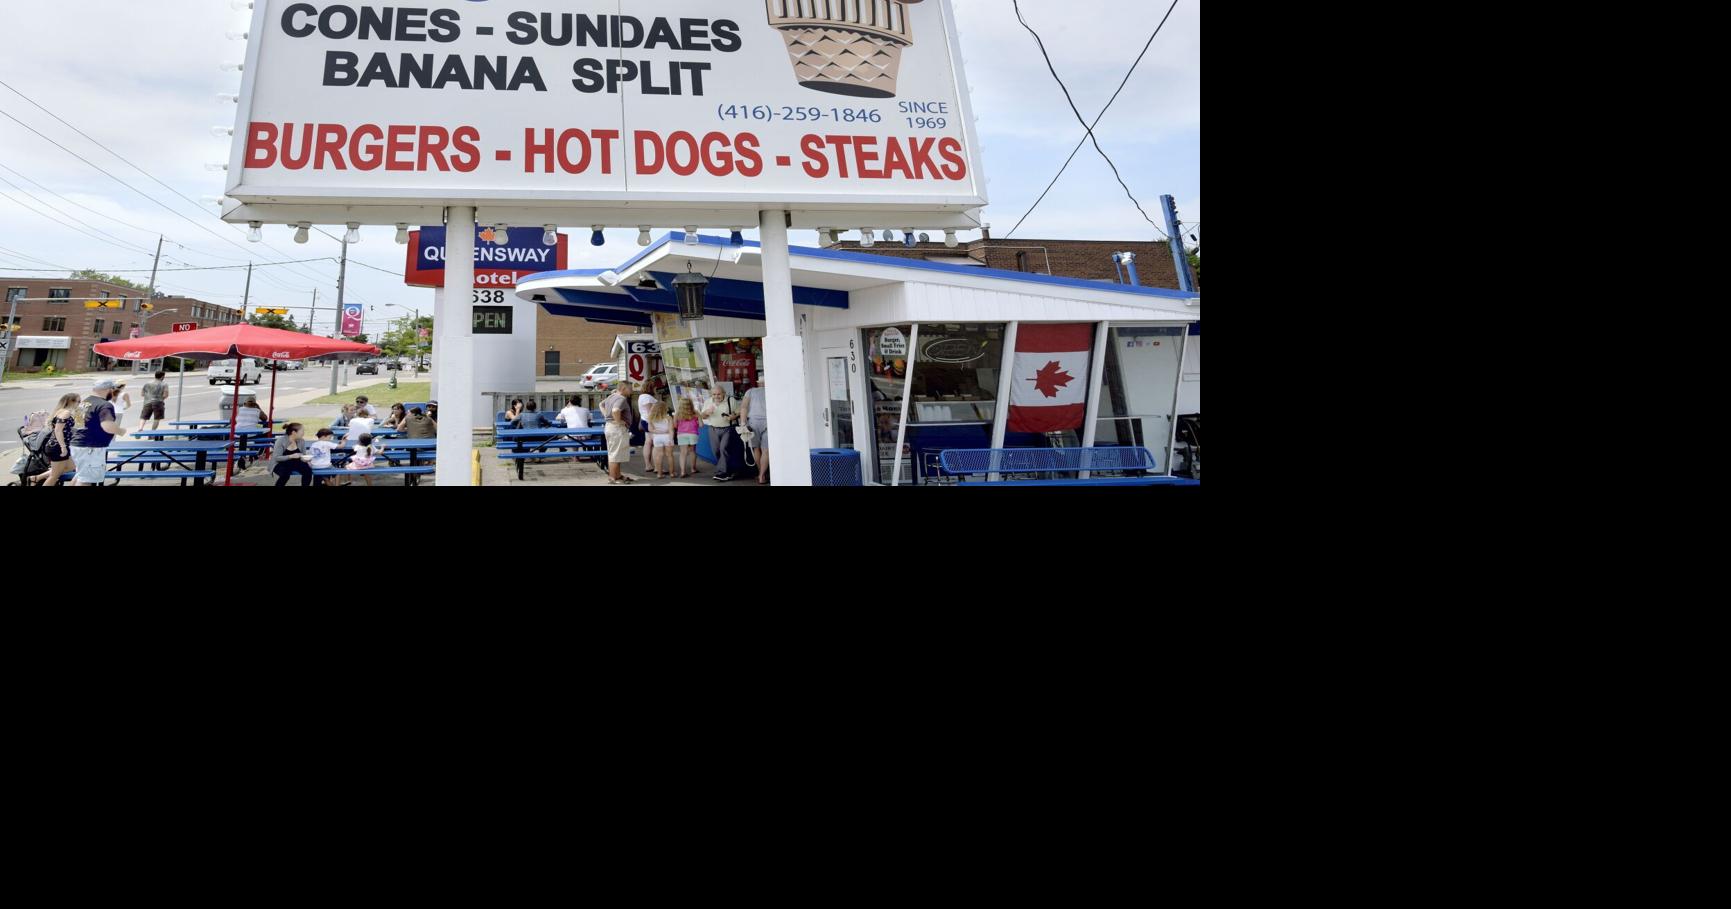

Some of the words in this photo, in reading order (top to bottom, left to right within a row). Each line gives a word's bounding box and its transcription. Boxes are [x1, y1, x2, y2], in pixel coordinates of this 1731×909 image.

[280, 3, 461, 42] CONES
[505, 11, 742, 53] SUNDAES
[322, 50, 548, 91] BANANA
[571, 57, 712, 96] SPLIT
[717, 103, 882, 124] (416)-259-1846
[898, 101, 949, 115] SINCE
[905, 116, 947, 129] 1969
[244, 121, 481, 173] BURGERS
[524, 128, 620, 175] HOT
[633, 130, 764, 177] DOGS
[800, 134, 967, 181] STEAKS
[424, 246, 550, 263] QUENSWAY
[473, 271, 517, 285] otel
[178, 323, 191, 332] NO
[473, 312, 506, 328] PEN
